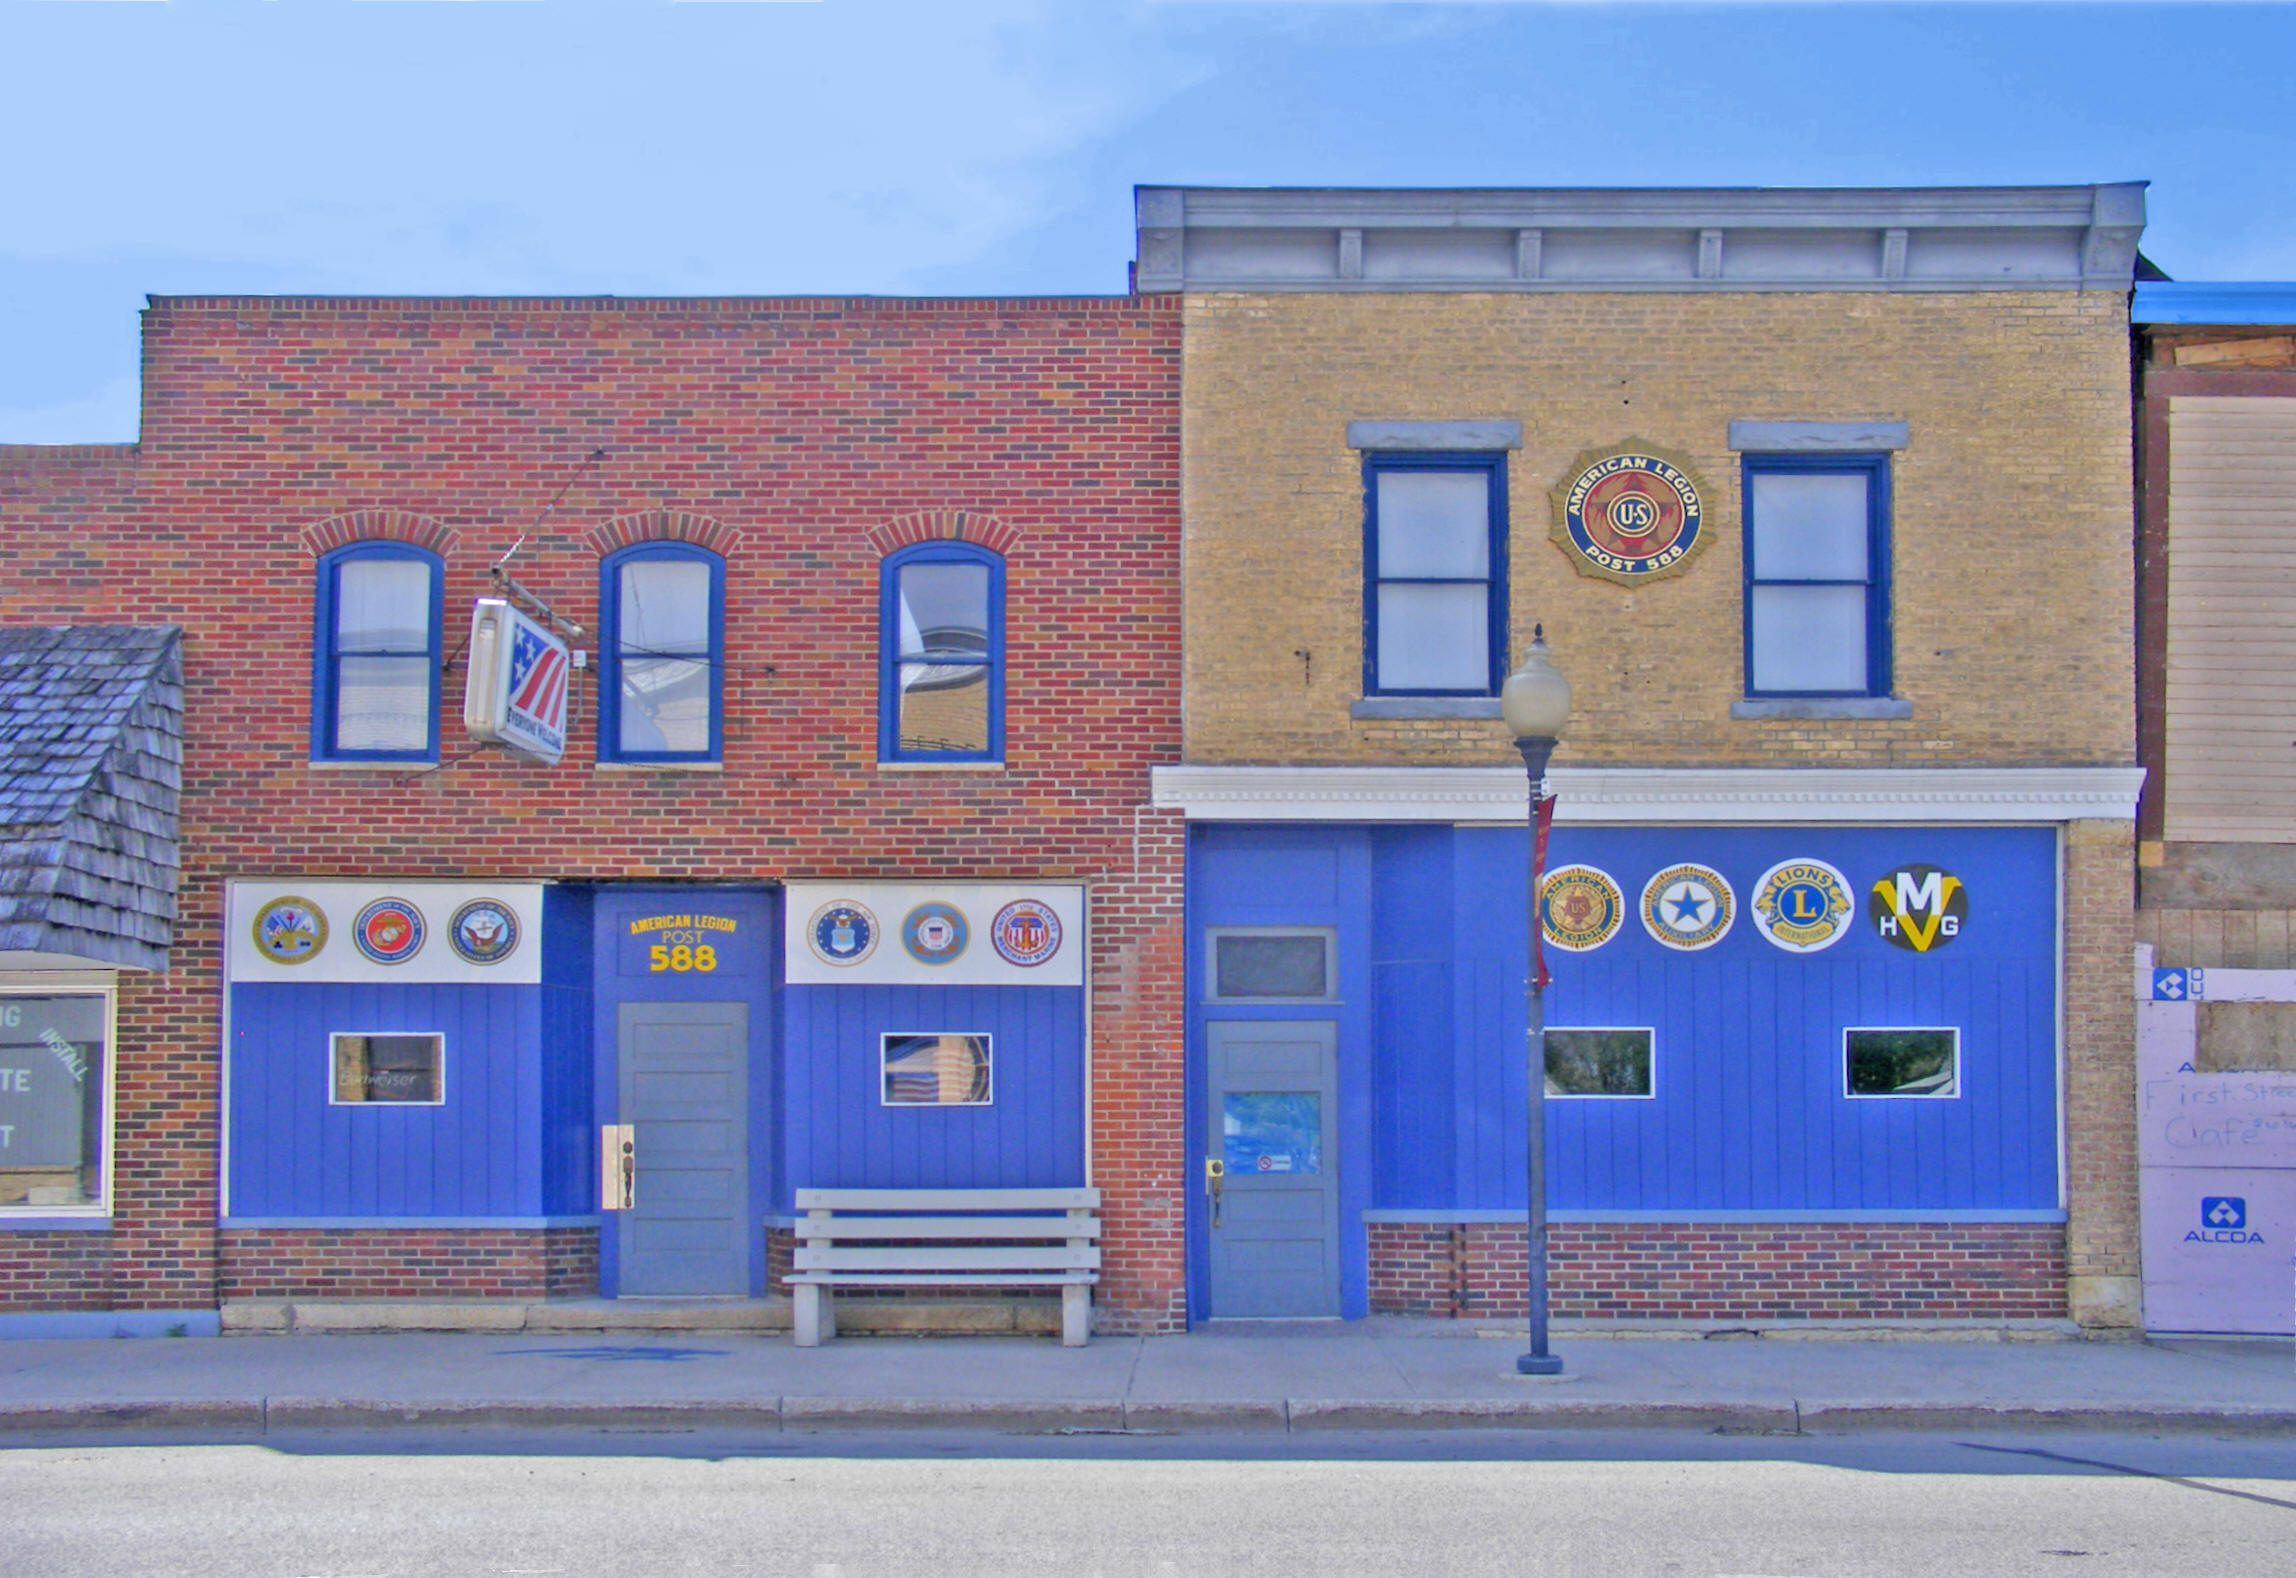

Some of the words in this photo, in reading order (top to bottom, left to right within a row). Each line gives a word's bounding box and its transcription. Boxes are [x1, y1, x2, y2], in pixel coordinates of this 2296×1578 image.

[1568, 457, 1647, 516] AMERICAN
[1655, 460, 1698, 517] LEGION
[1586, 545, 1635, 571] POST
[1647, 545, 1683, 570] 588
[1547, 876, 1610, 900] AMERICAN
[1776, 867, 1830, 885] LIONS
[1793, 890, 1817, 917] L
[630, 915, 691, 934] AMERICAN
[694, 914, 737, 933] LEGION
[1554, 927, 1602, 940] LEGION
[662, 930, 704, 944] POST
[650, 944, 717, 972] 588
[39, 1027, 88, 1082] INSTALL
[340, 1070, 416, 1087] Bdweiser
[2146, 1080, 2232, 1110] First
[2184, 1230, 2265, 1244] ALCOA
